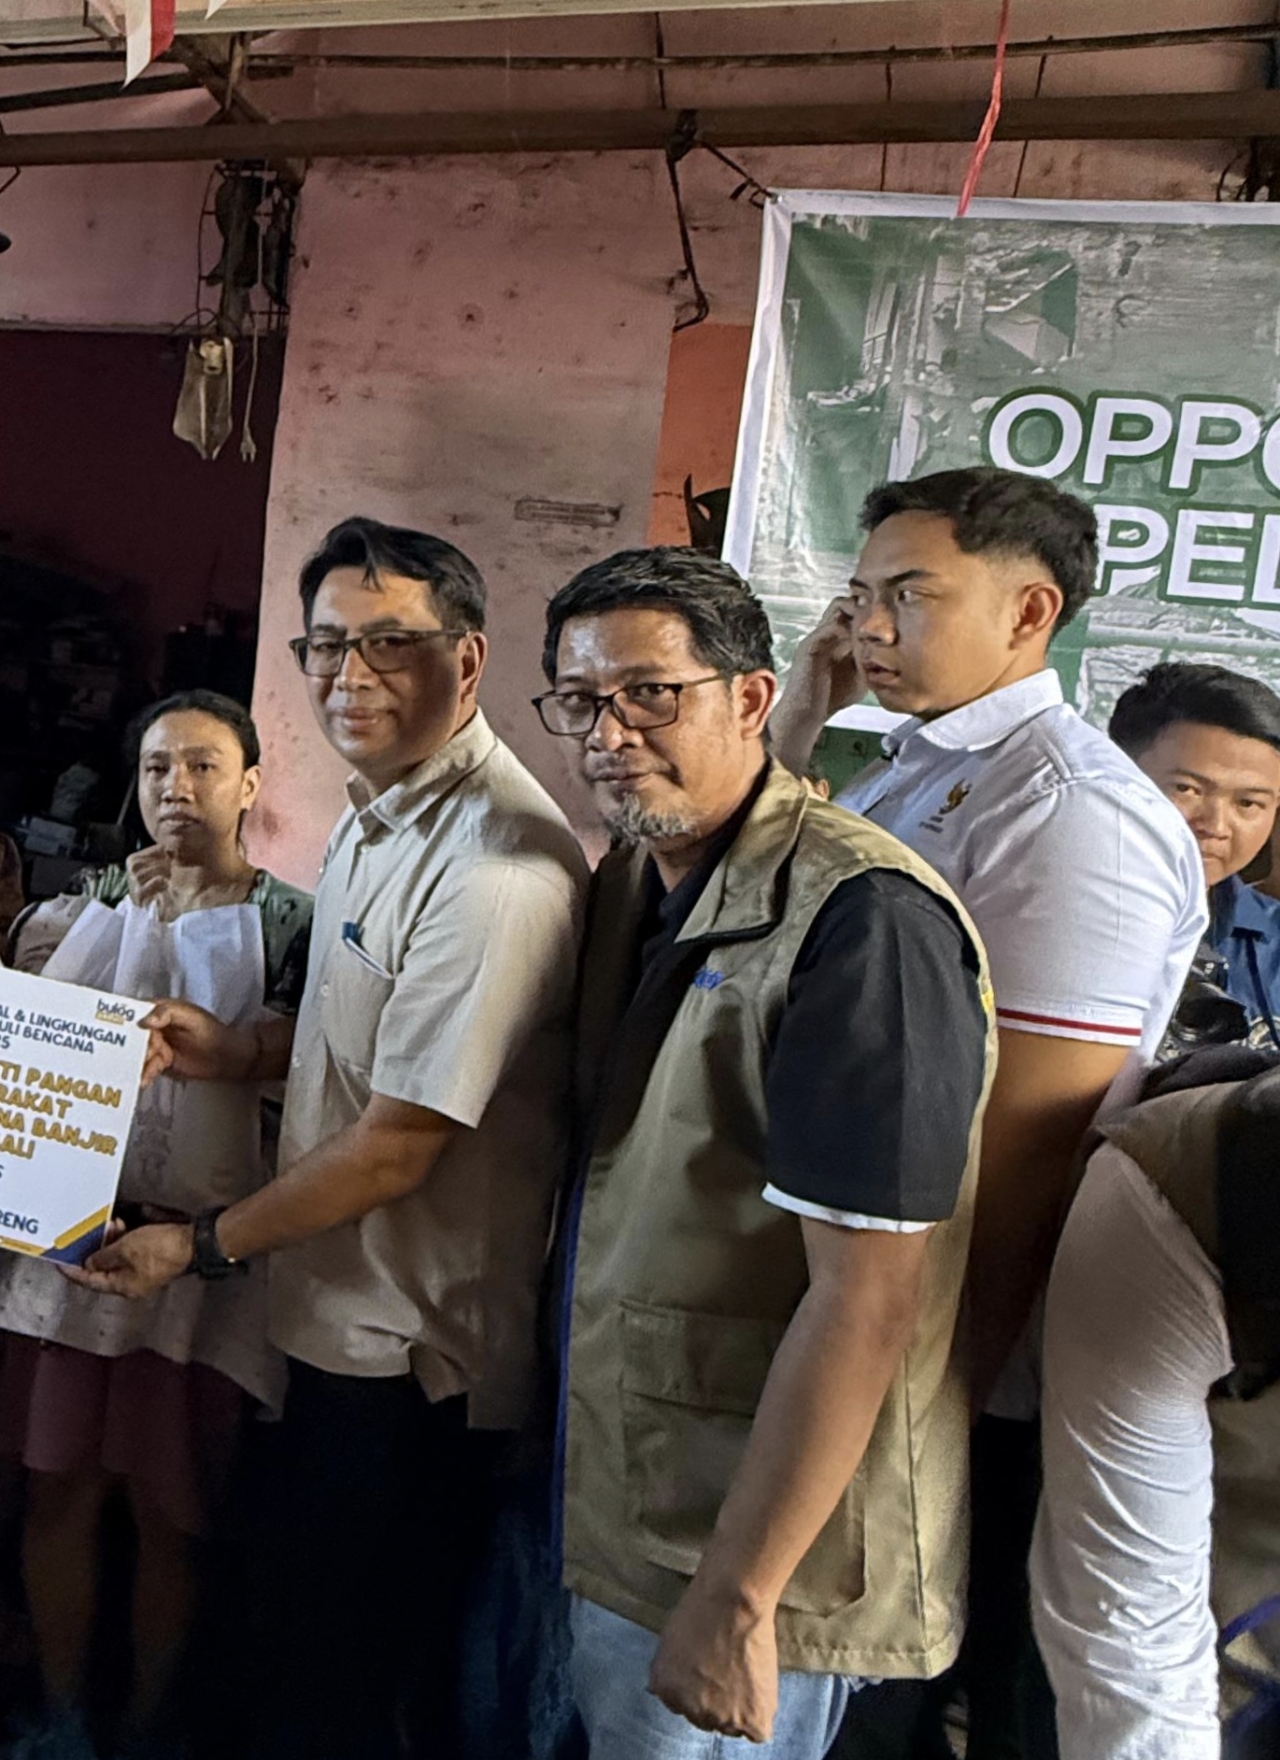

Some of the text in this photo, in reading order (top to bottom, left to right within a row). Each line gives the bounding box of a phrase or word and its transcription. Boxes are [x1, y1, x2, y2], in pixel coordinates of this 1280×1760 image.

[989, 393, 1280, 493] OPP
[1093, 504, 1280, 603] PE
[13, 1009, 25, 1022] &
[29, 1012, 126, 1046] LINGKUNGAN
[22, 1025, 93, 1054] BENCANA
[24, 1067, 122, 1108] PANGAN
[30, 1117, 118, 1156] BANJIR
